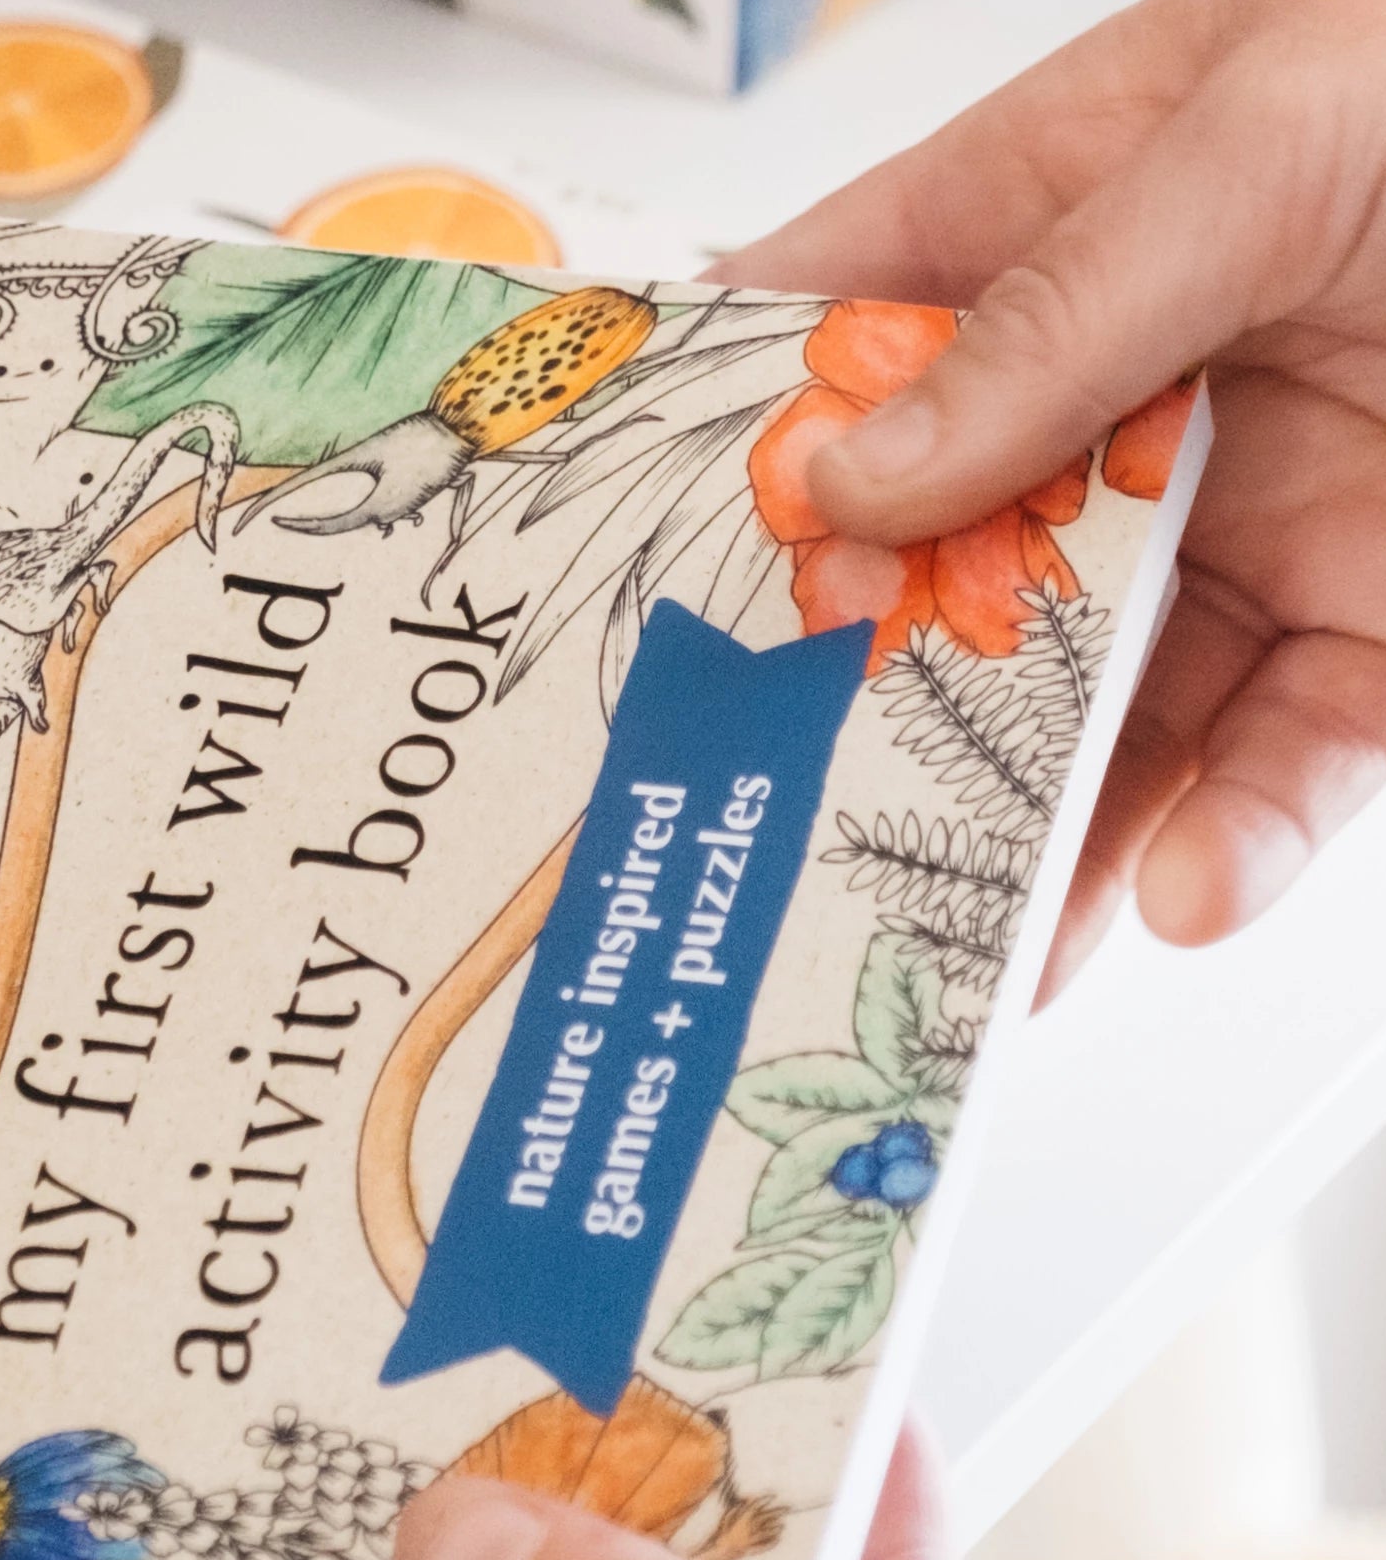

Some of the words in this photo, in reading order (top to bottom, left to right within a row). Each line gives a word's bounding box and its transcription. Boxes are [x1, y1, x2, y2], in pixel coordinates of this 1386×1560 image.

[14, 870, 215, 1127] first
[167, 573, 345, 831] wild
[290, 582, 530, 883] book
[668, 773, 773, 986] puzzles
[507, 1019, 605, 1208] nature
[560, 782, 687, 1008] inspired
[651, 1003, 694, 1038] +
[173, 917, 411, 1386] activity
[583, 1055, 677, 1240] games
